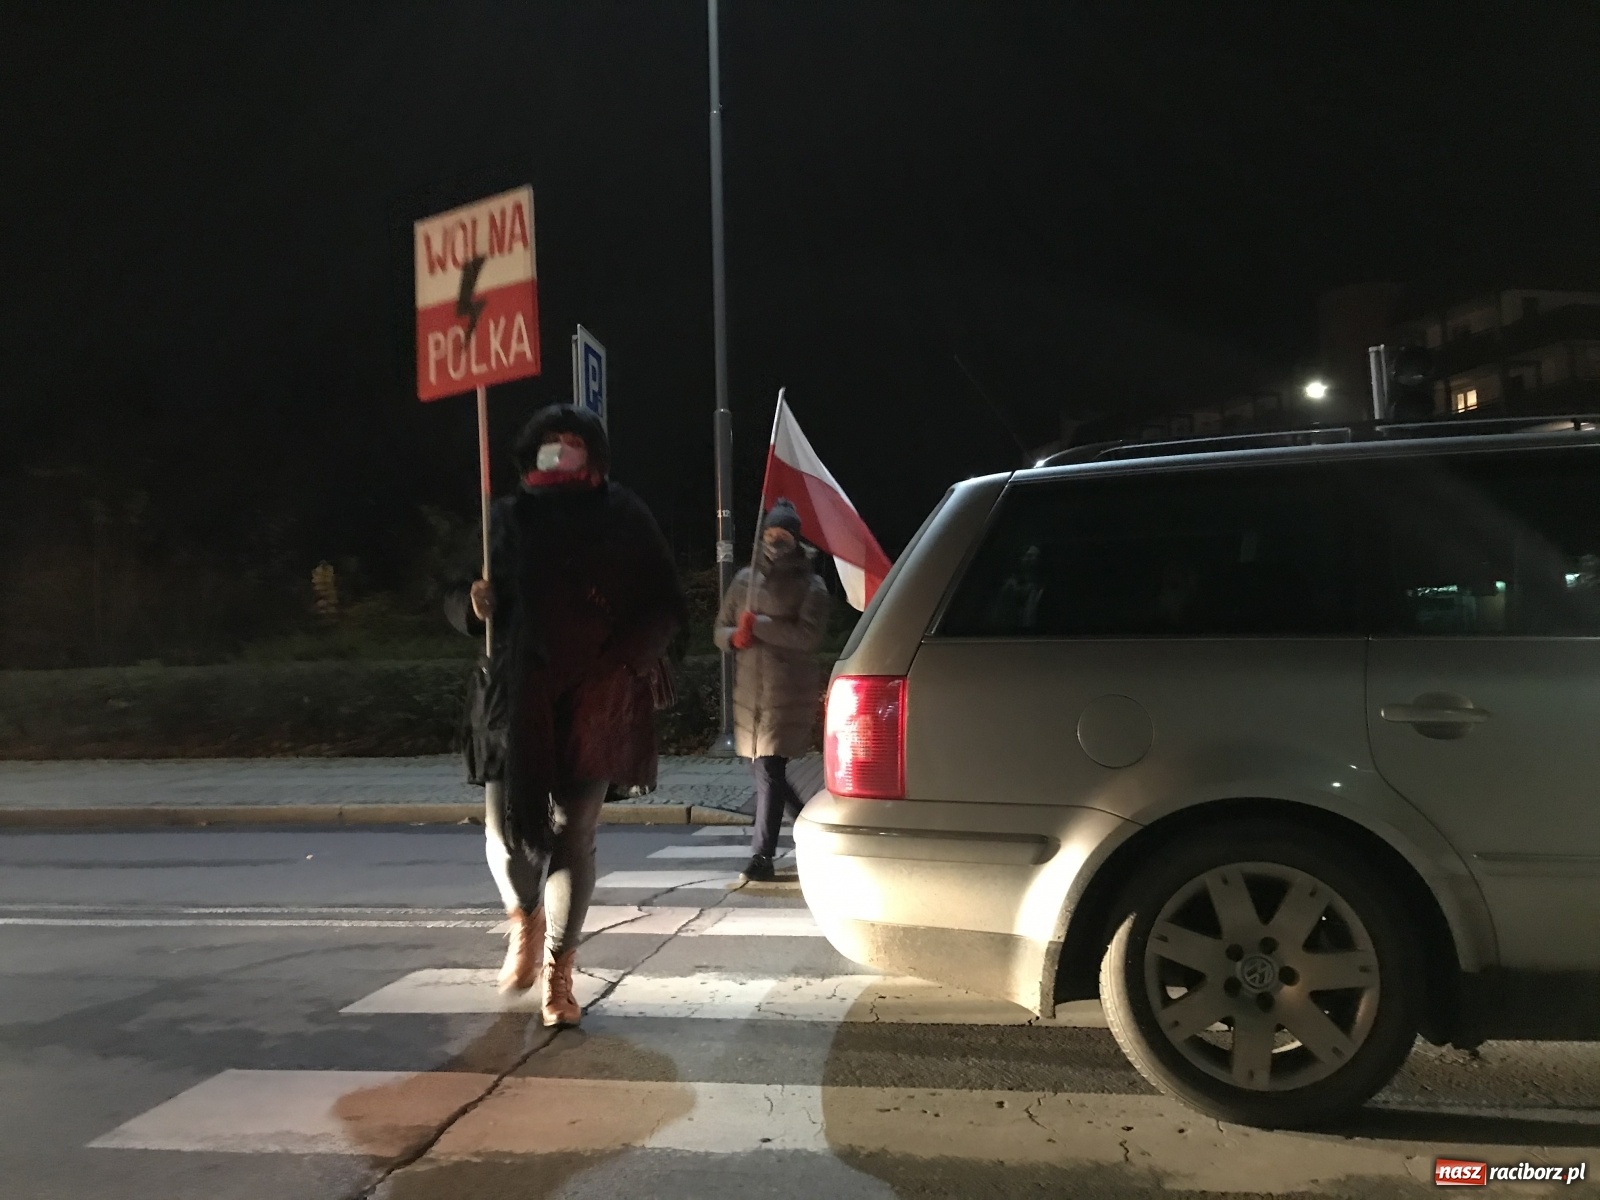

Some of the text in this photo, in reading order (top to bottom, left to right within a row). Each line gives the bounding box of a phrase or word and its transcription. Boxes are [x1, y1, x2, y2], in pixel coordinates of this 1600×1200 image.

[423, 201, 529, 276] WOLNA
[428, 311, 533, 386] POLKA
[588, 353, 599, 403] P
